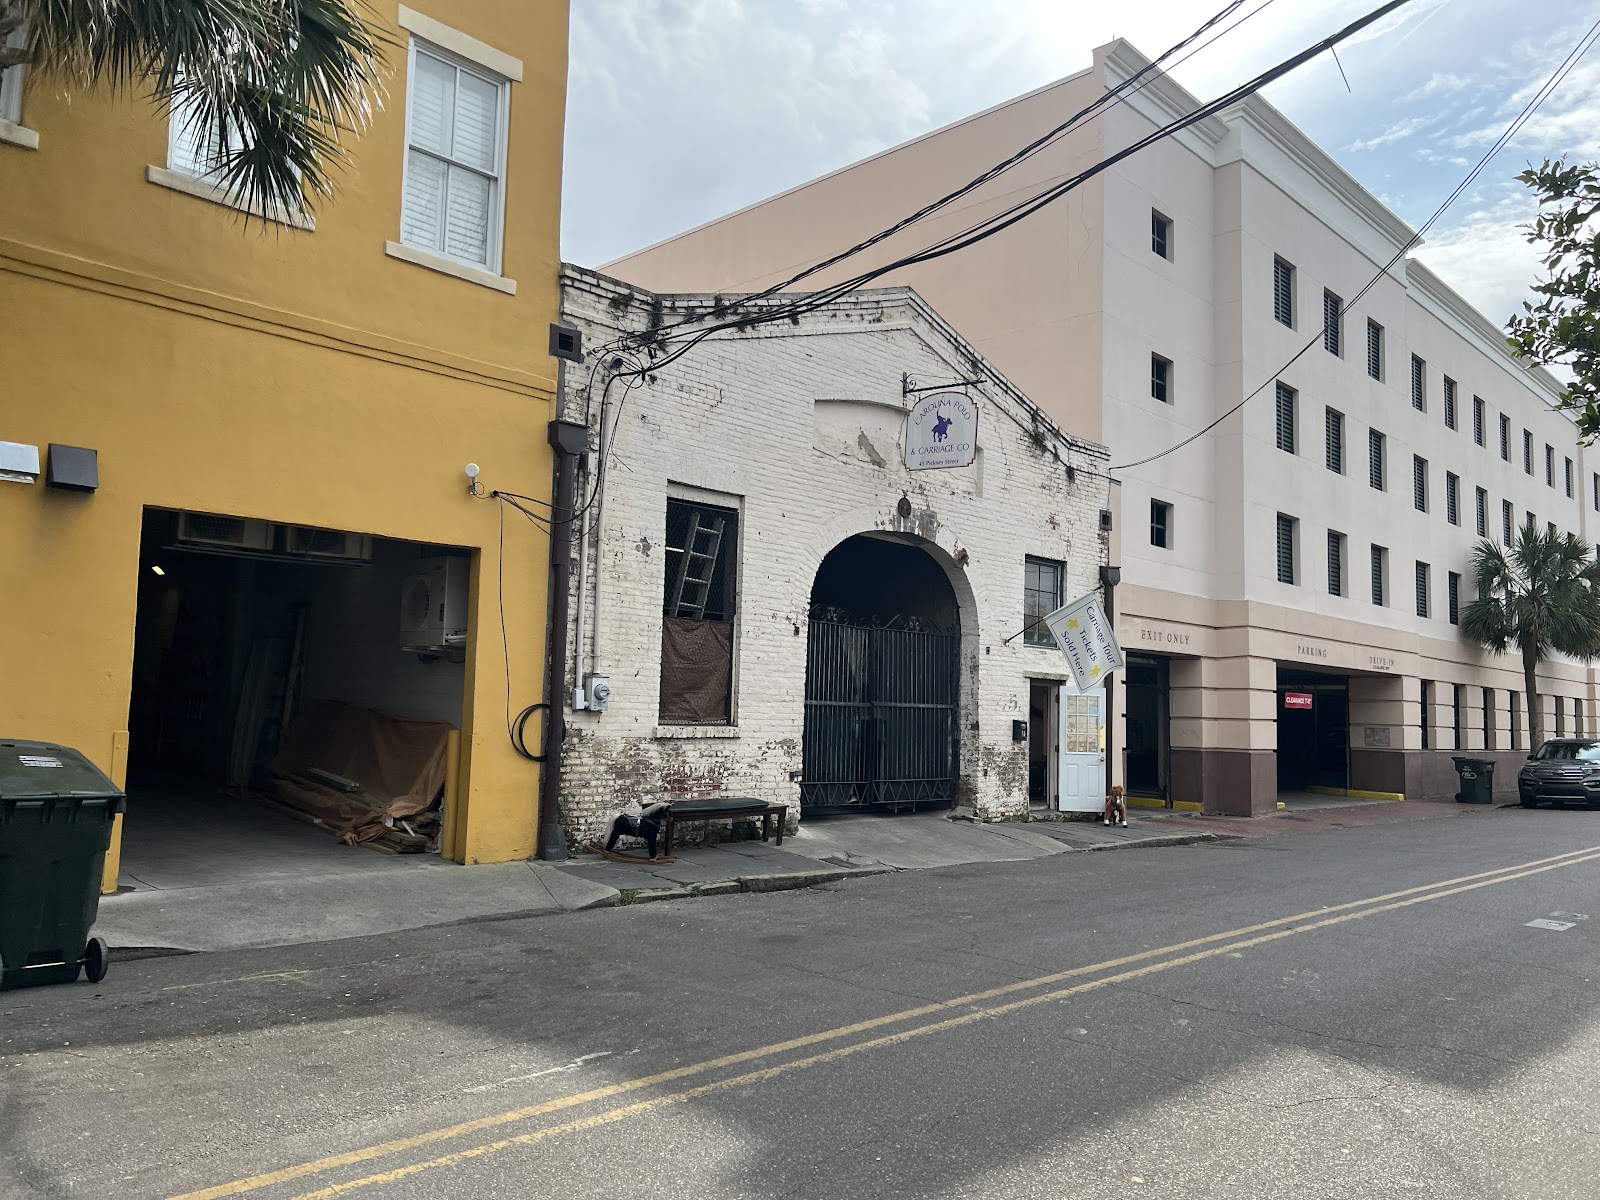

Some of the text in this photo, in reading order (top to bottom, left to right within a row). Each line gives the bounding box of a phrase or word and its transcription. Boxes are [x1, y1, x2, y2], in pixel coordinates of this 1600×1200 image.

[915, 400, 970, 425] CAROLINA POLO
[918, 444, 954, 455] CARRIAGE
[956, 443, 970, 452] CO
[1079, 628, 1098, 662] Tickets
[1086, 606, 1116, 664] Carriage Tour
[1141, 629, 1190, 645] EXIT ONLY
[1061, 630, 1085, 676] Sold Here
[1297, 645, 1327, 658] PARKING
[1369, 656, 1395, 667] DRIVE-IN
